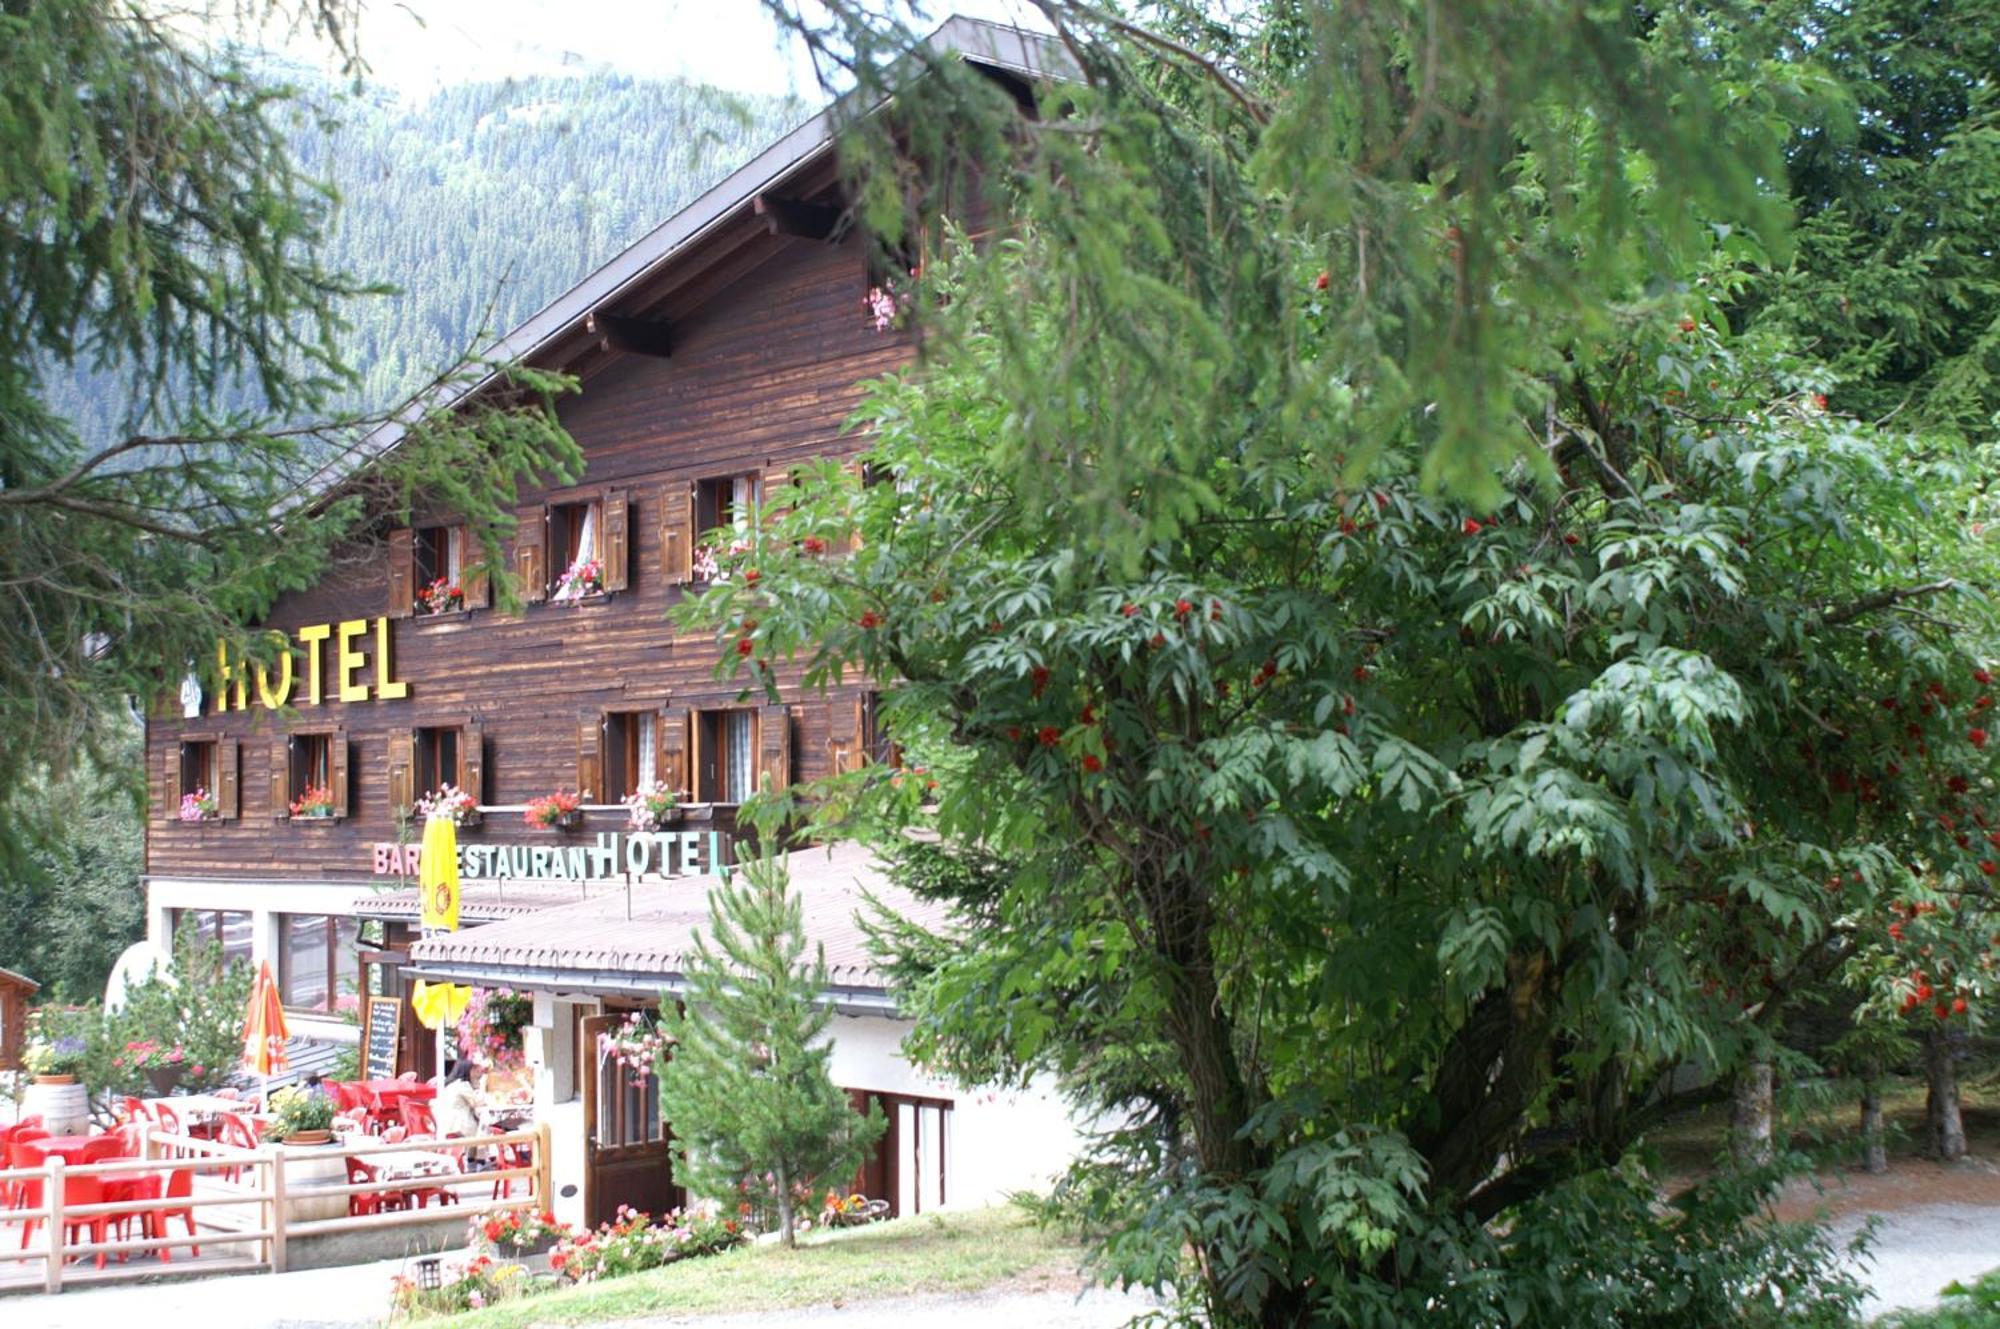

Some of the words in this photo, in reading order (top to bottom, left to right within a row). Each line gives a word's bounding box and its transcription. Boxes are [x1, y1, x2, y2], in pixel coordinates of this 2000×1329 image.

[217, 616, 406, 712] HOTEL
[373, 842, 423, 875] BAR
[455, 843, 602, 881] ESTAURANT
[597, 831, 730, 877] HOTEL
